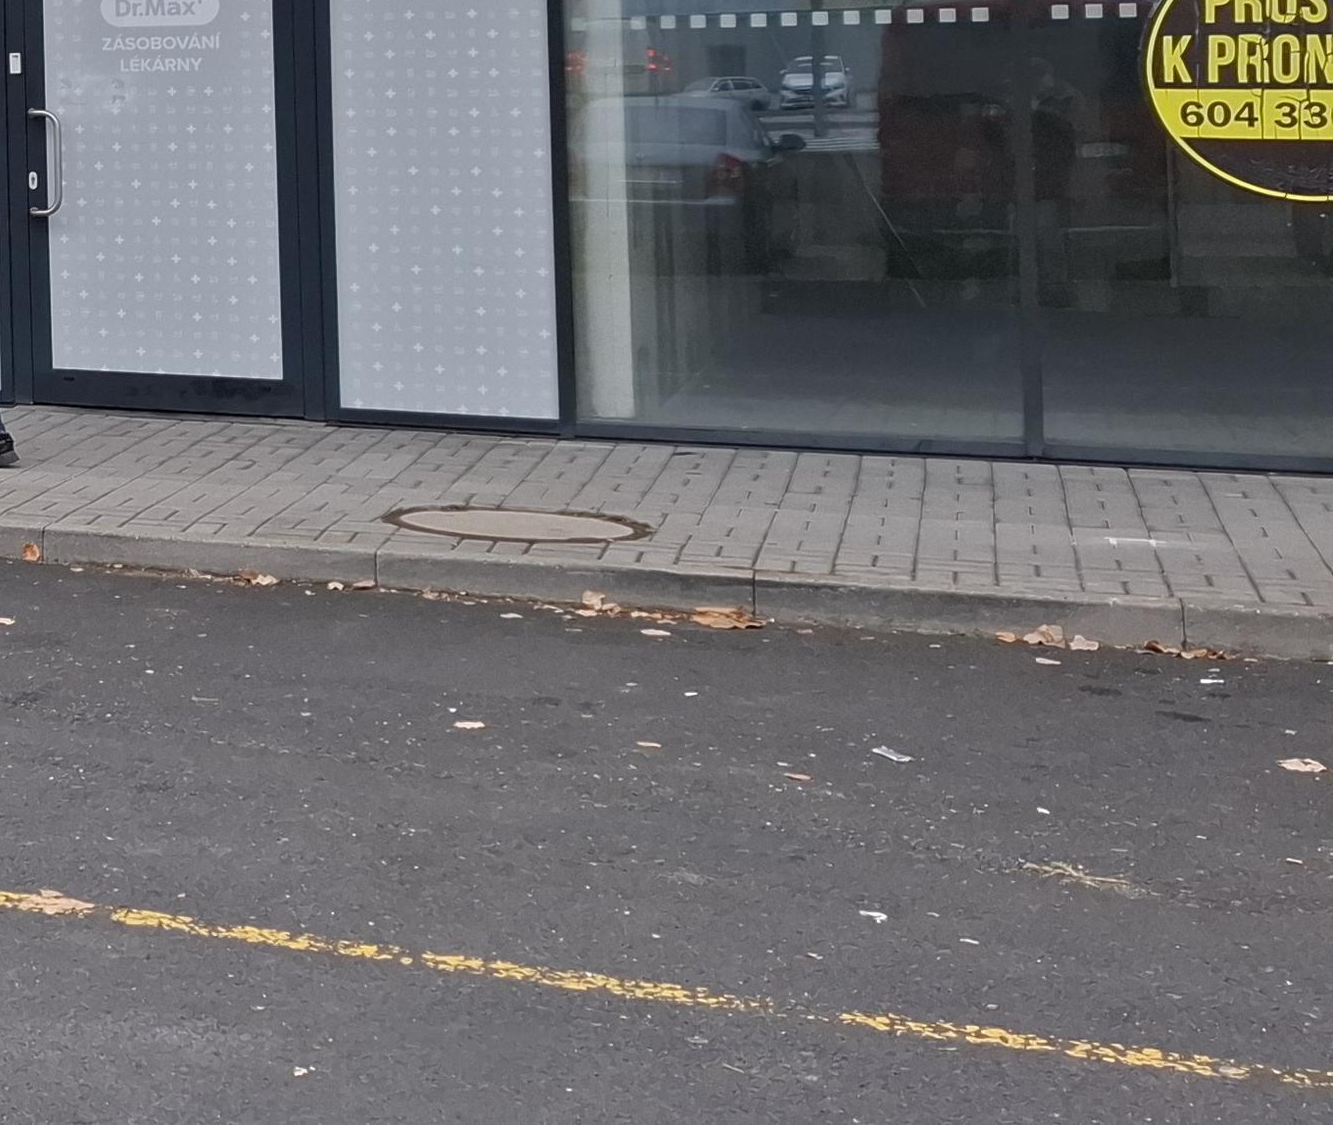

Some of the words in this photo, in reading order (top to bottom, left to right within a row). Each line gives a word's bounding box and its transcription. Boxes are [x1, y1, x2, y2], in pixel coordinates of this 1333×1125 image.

[101, 31, 221, 52] ZÁSOBOVÁNÍ
[119, 55, 203, 73] LÉKÁRNY
[1162, 34, 1192, 84] K
[1180, 100, 1259, 128] 604
[1273, 101, 1333, 128] 33
